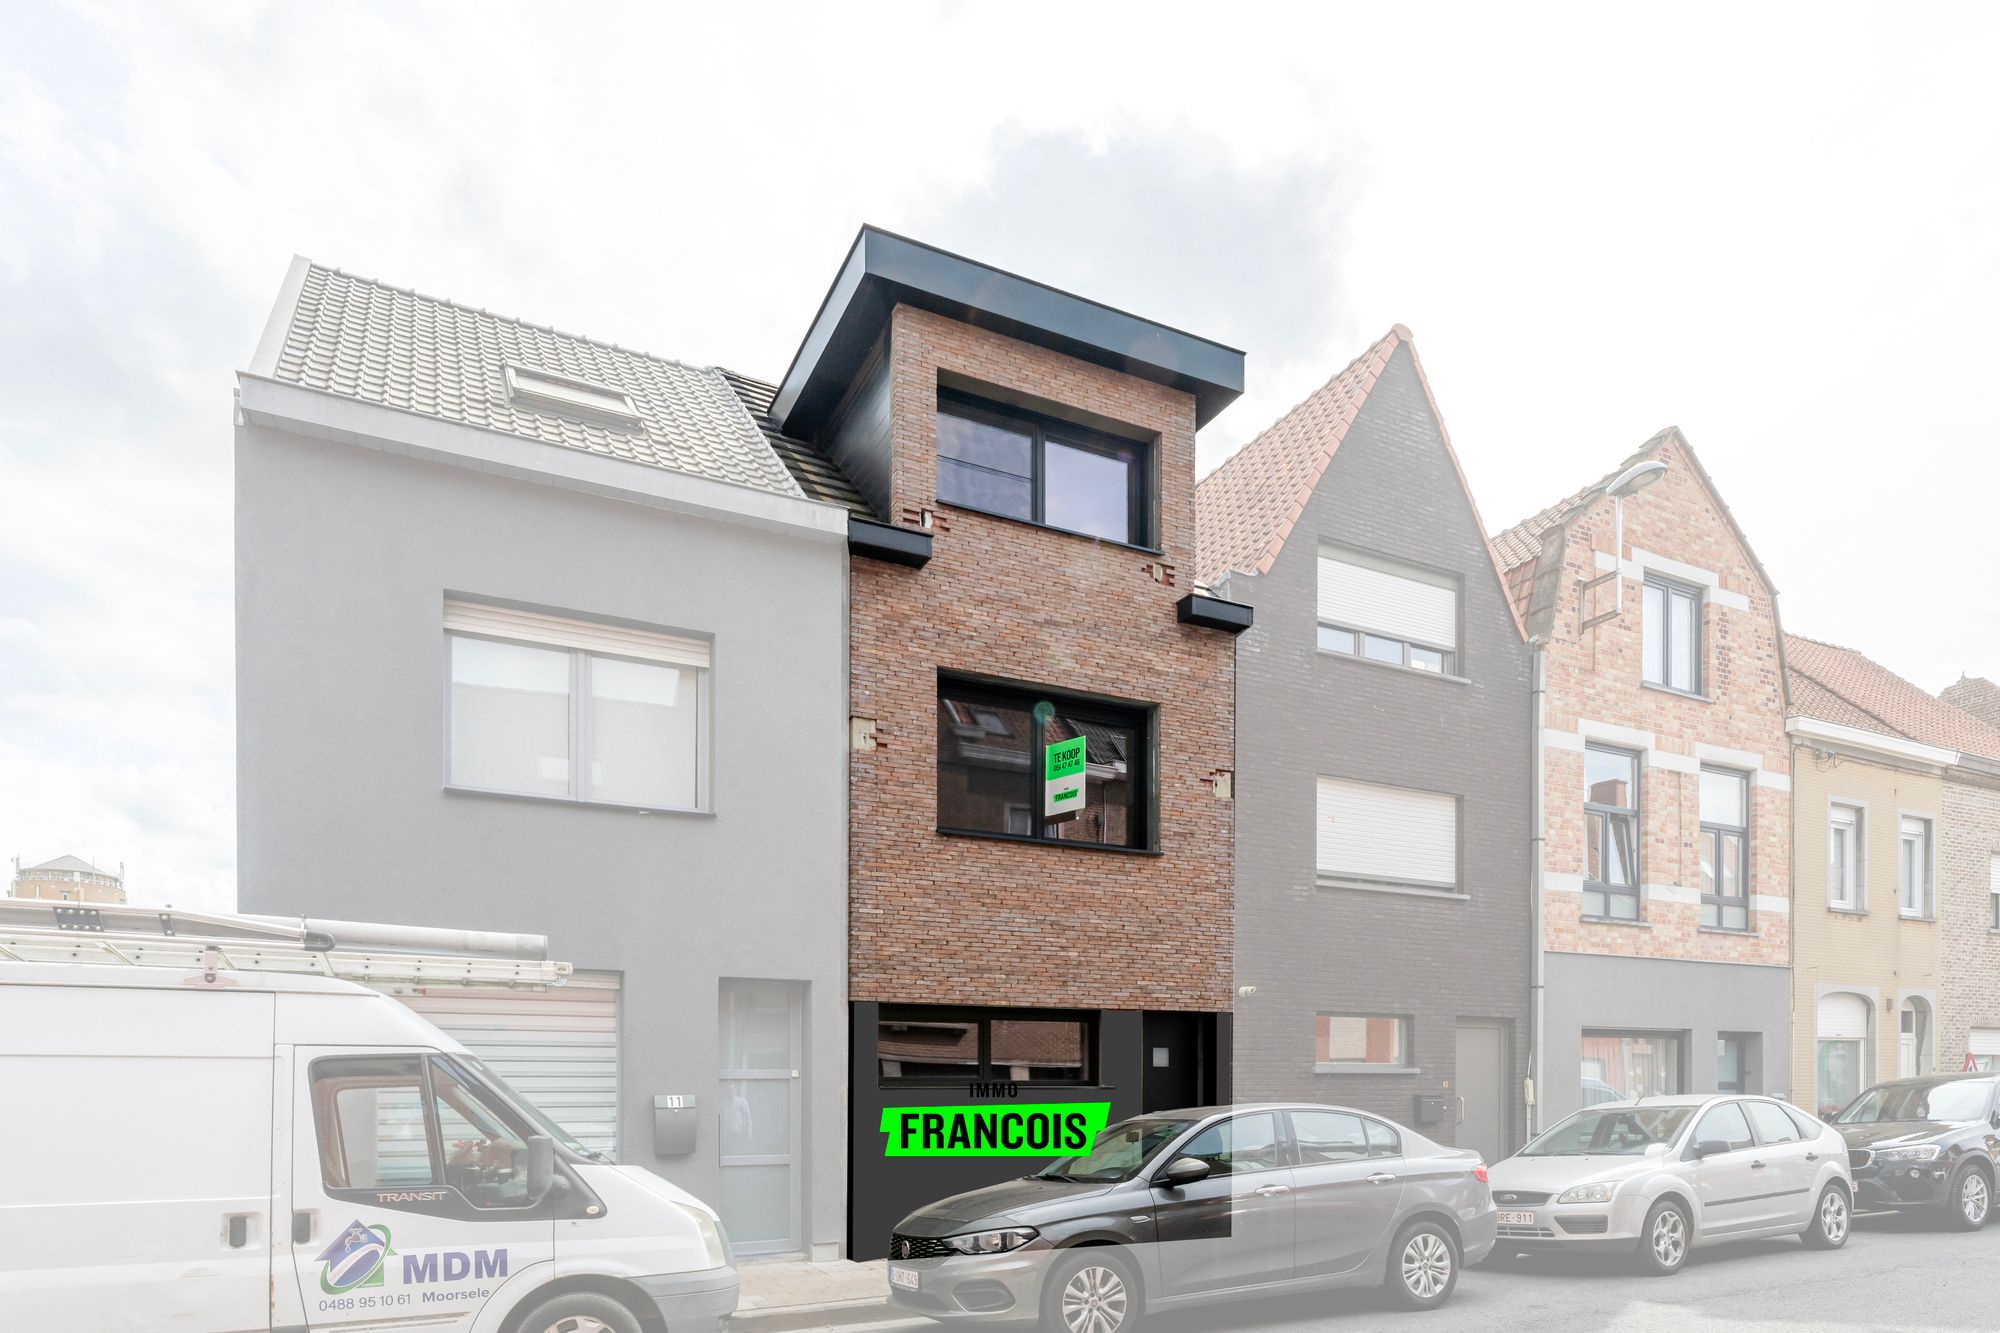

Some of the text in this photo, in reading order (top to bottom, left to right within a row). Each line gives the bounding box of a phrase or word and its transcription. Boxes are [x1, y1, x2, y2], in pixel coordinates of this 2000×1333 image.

[1053, 747, 1080, 764] TE KOOP
[669, 1096, 681, 1107] 11
[376, 1191, 447, 1203] TRANSIT
[403, 1248, 508, 1285] MDM
[318, 1286, 490, 1312] 0488 95 10 61 Moorsele
